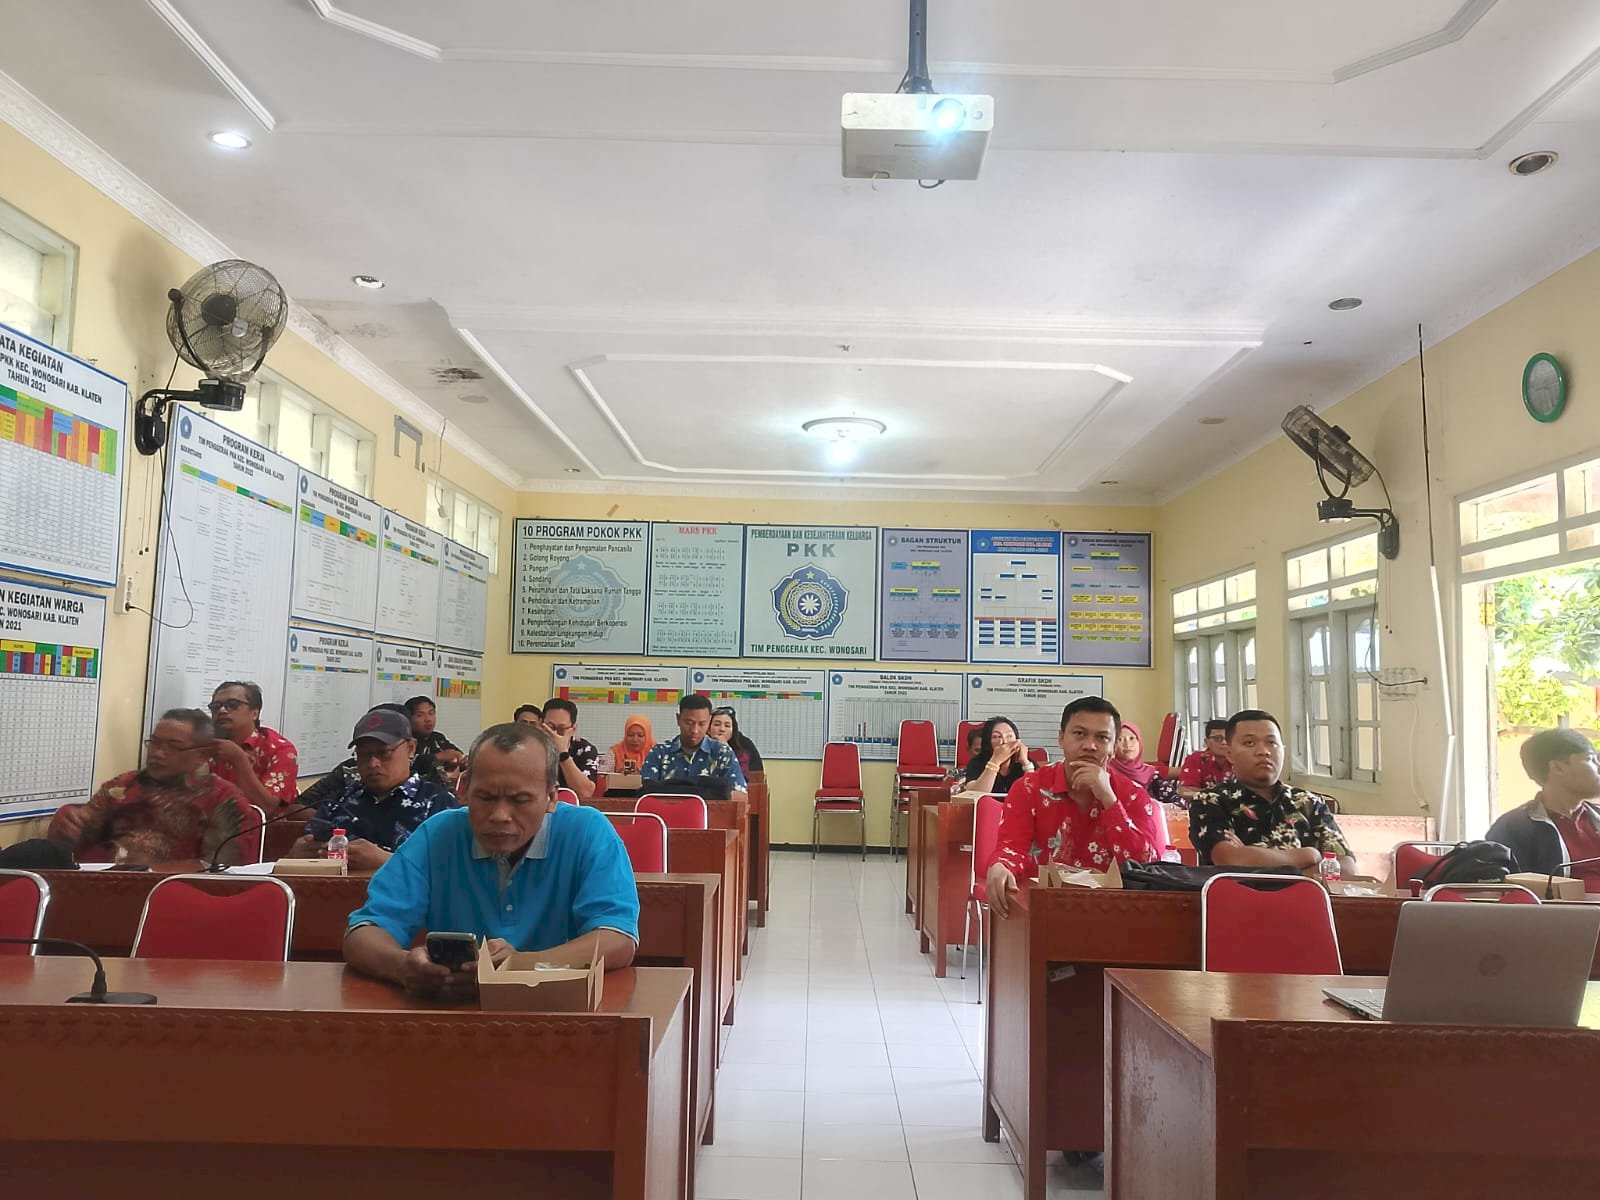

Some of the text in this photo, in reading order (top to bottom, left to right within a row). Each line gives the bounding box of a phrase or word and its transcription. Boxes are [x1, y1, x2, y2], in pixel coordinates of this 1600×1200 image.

[19, 344, 63, 373] KEGIATAN
[0, 353, 102, 404] PKK KEC. WONOSARI KAB. KLATEN
[8, 369, 46, 393] TAHUN 2021
[223, 435, 265, 462] PROGRAM KERJA
[523, 526, 642, 538] 10 PROGRAM POKOK PKK
[679, 526, 717, 535] MARS PKK
[751, 529, 791, 539] PEMBERDAYAAN
[793, 530, 803, 539] DAN
[847, 531, 872, 540] KELUARGA
[530, 544, 563, 552] Penghayatan
[575, 544, 607, 553] Pengamalan
[529, 554, 548, 562] Gotong
[529, 565, 548, 573] Pangan
[8, 590, 51, 608] KEGIATAN
[54, 598, 84, 613] WARGA
[8, 607, 41, 620] WONOSARI
[43, 612, 56, 622] KAB.
[58, 614, 79, 625] KLATEN
[6, 620, 21, 630] 2021
[767, 644, 808, 653] PENGGERAK
[810, 646, 826, 654] KEC.
[829, 646, 866, 655] WONOSARI
